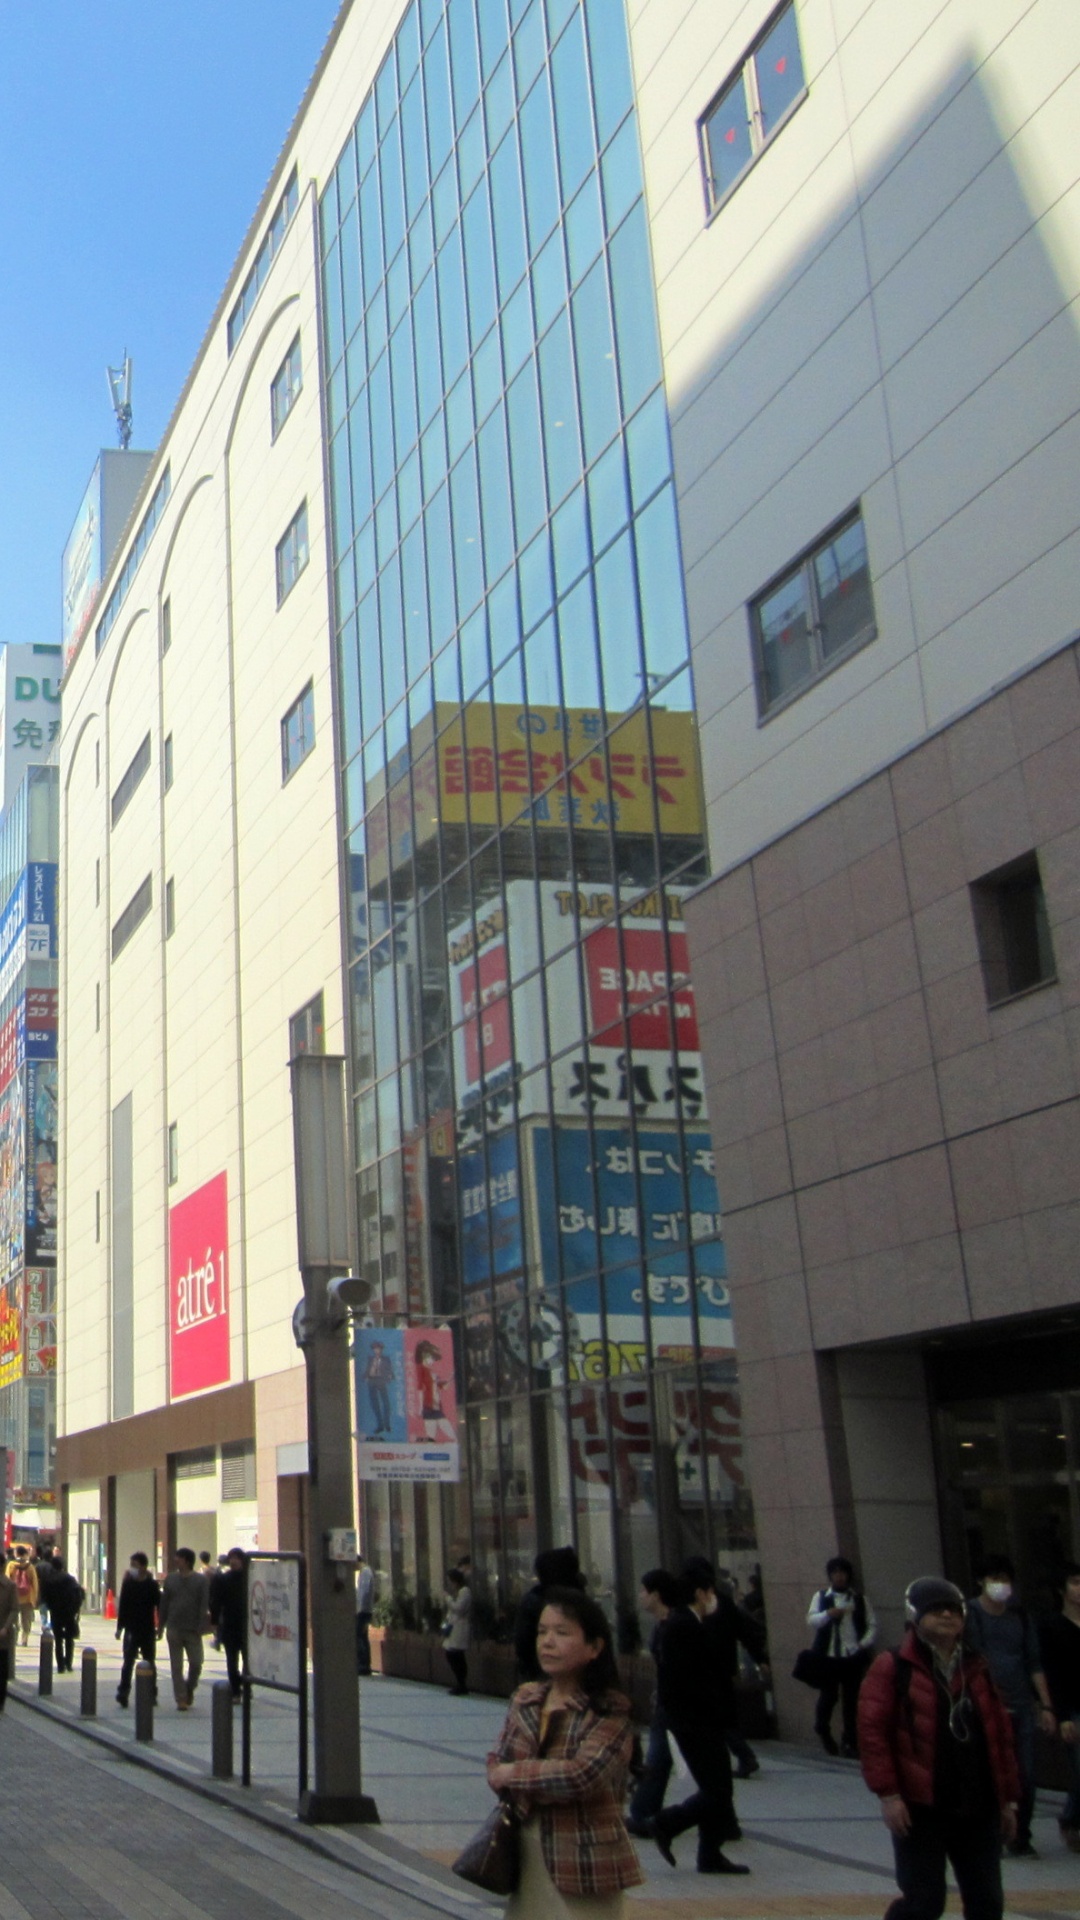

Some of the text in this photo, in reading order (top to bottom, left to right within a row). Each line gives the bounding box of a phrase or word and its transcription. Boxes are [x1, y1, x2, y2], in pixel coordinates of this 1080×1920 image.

[15, 676, 62, 703] DU
[29, 938, 48, 952] 7F
[177, 1246, 216, 1328] atré
